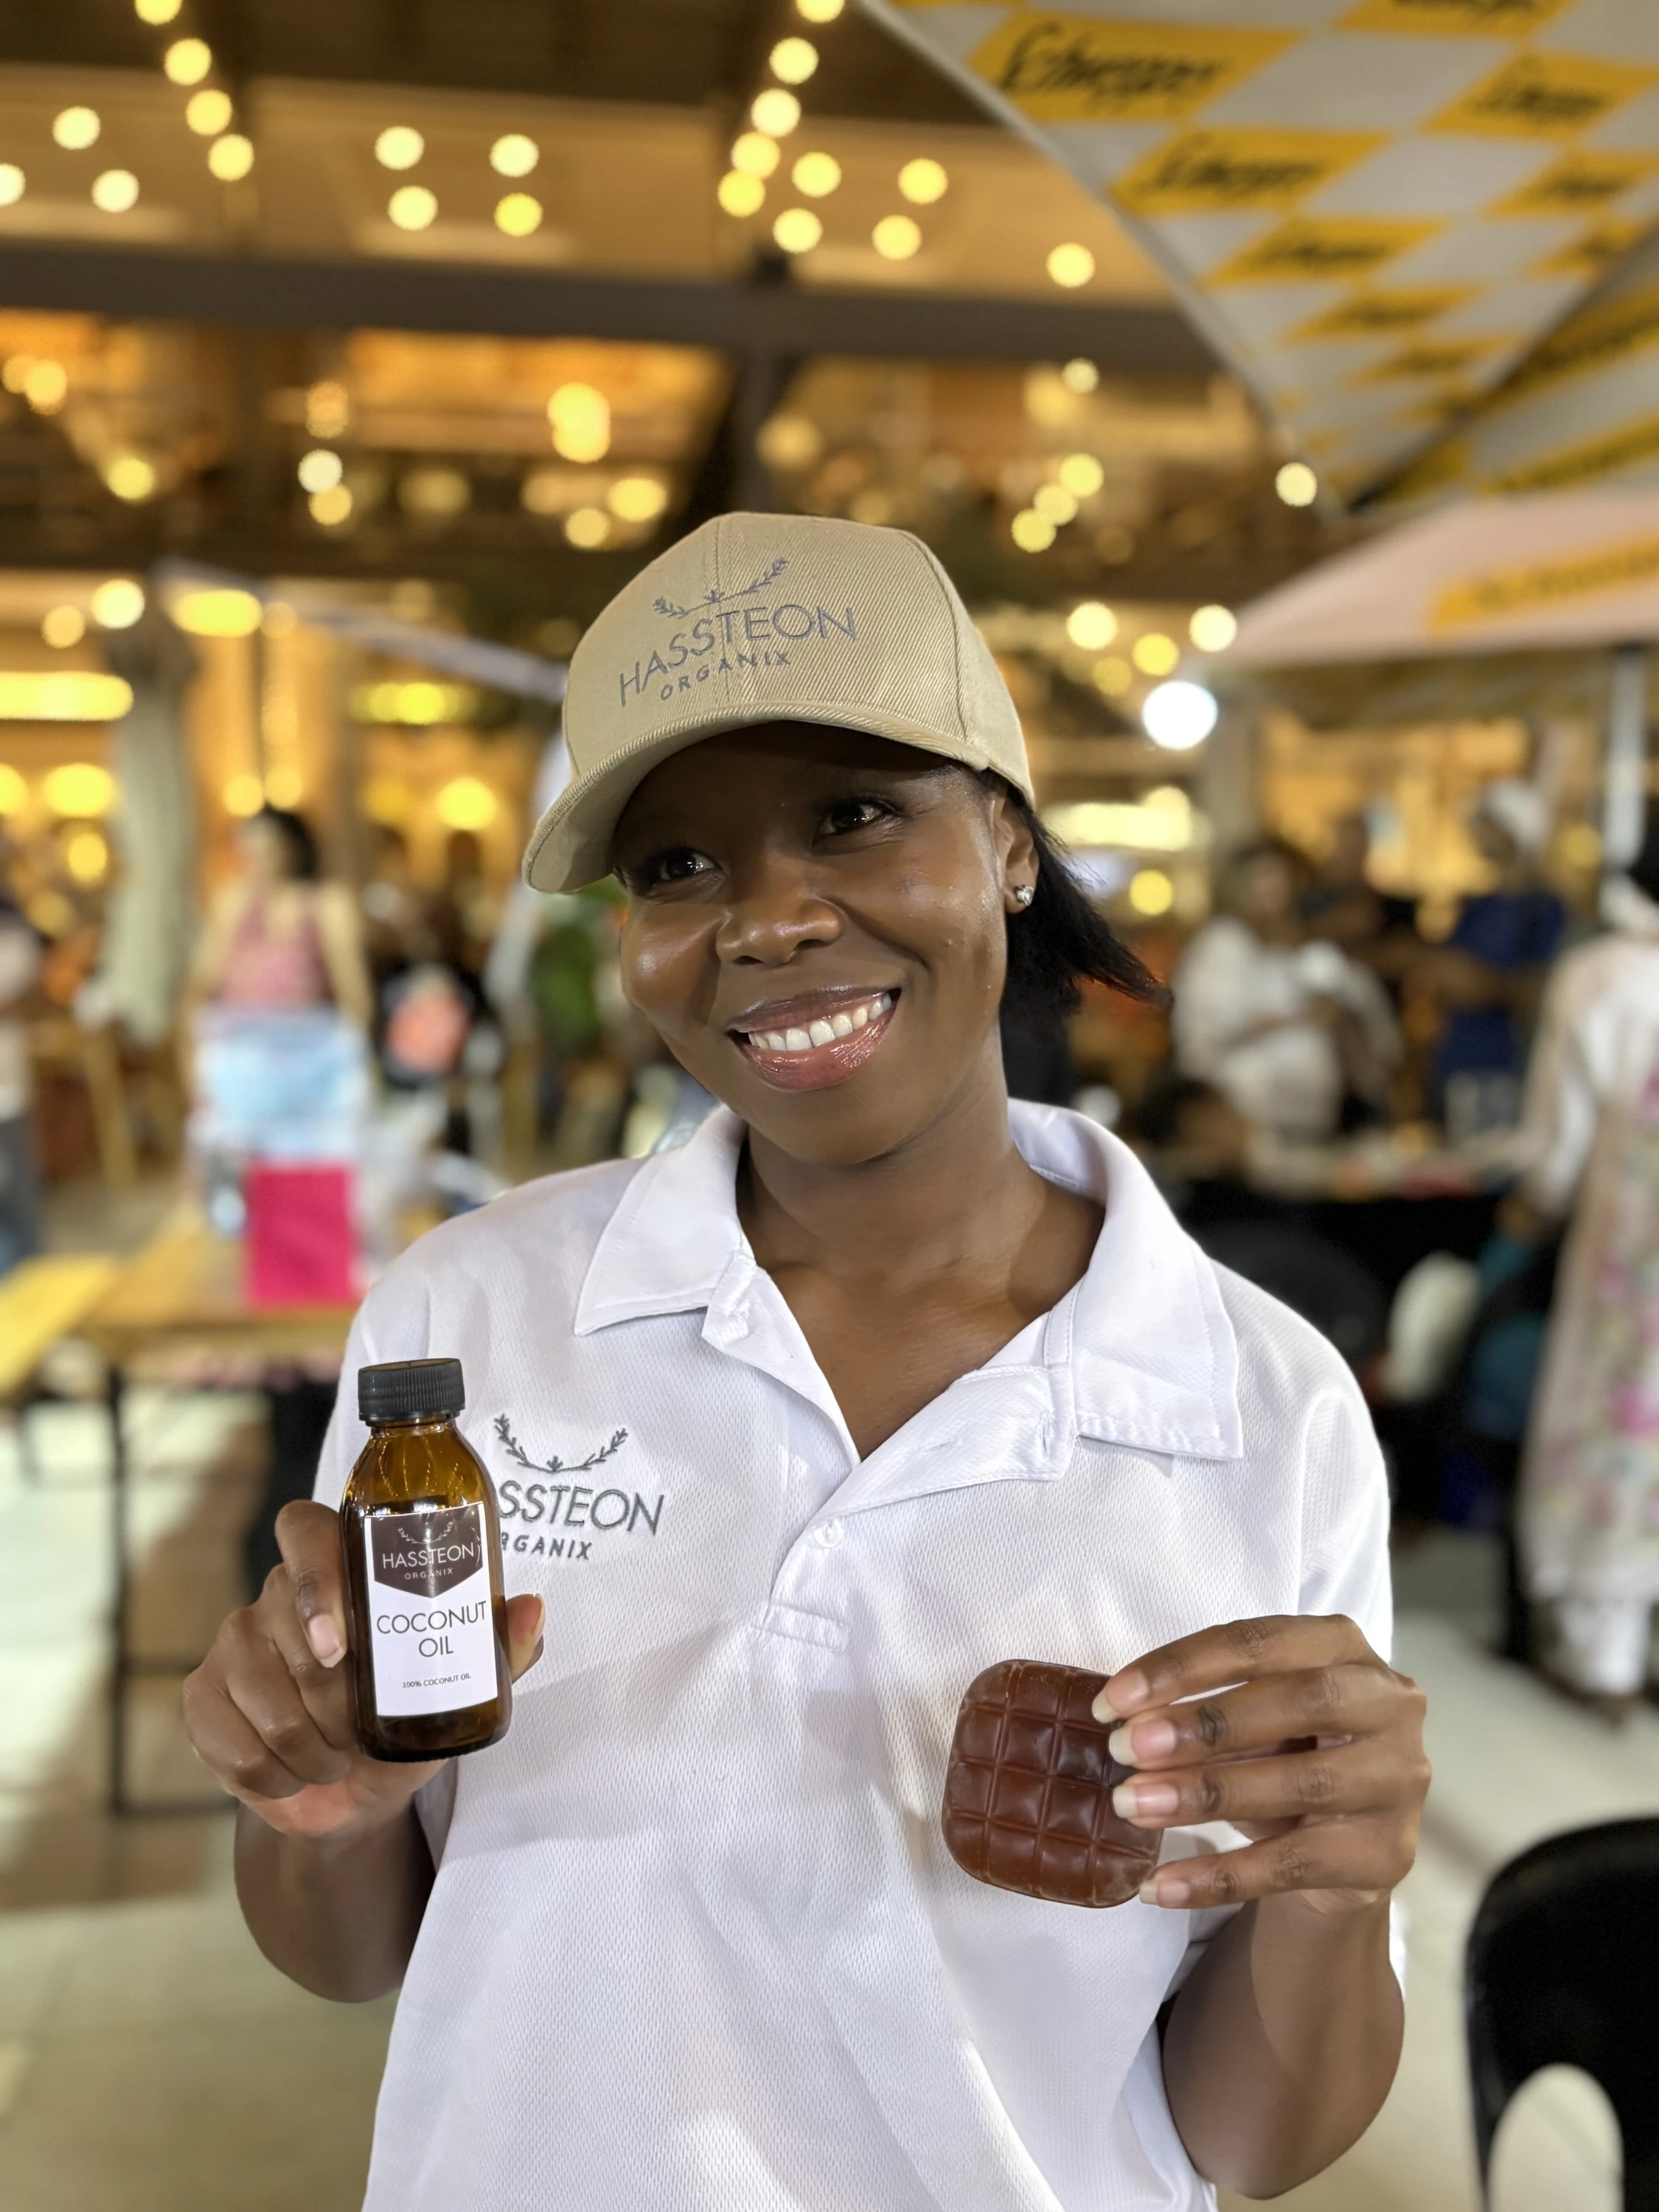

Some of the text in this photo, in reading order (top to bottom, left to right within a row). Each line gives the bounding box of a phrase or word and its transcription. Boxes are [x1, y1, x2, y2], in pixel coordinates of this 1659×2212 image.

[619, 603, 857, 707] HASSTEON
[660, 650, 791, 701] ORGANIX
[498, 1479, 664, 1537] SSTEON
[381, 1541, 475, 1570] HASSTEON
[501, 1531, 592, 1561] RGANIX
[404, 1567, 454, 1580] ORGANIX
[376, 1600, 487, 1635] COCONUT
[418, 1635, 454, 1658] OIL
[403, 1672, 472, 1688] 100% COCONUT OIL
